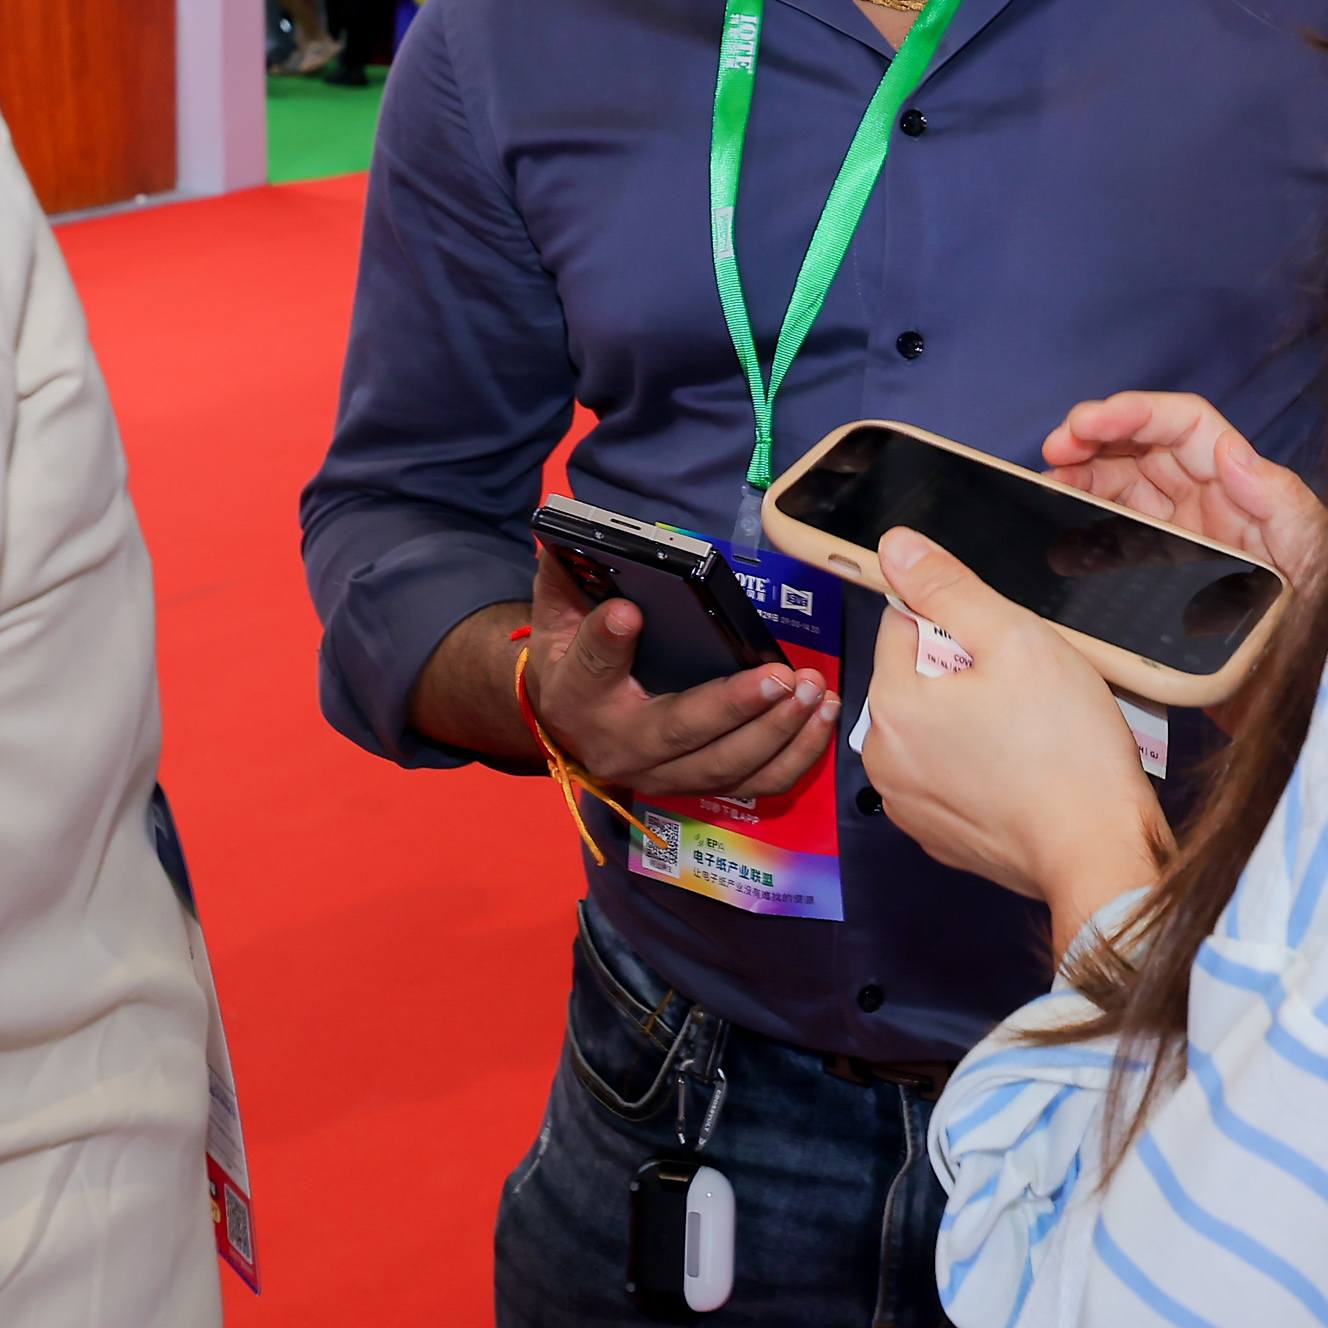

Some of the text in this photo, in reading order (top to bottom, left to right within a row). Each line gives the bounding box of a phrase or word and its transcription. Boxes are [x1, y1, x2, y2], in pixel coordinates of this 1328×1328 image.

[733, 571, 767, 593] OTE
[693, 850, 774, 888] 电子纸产业联盟
